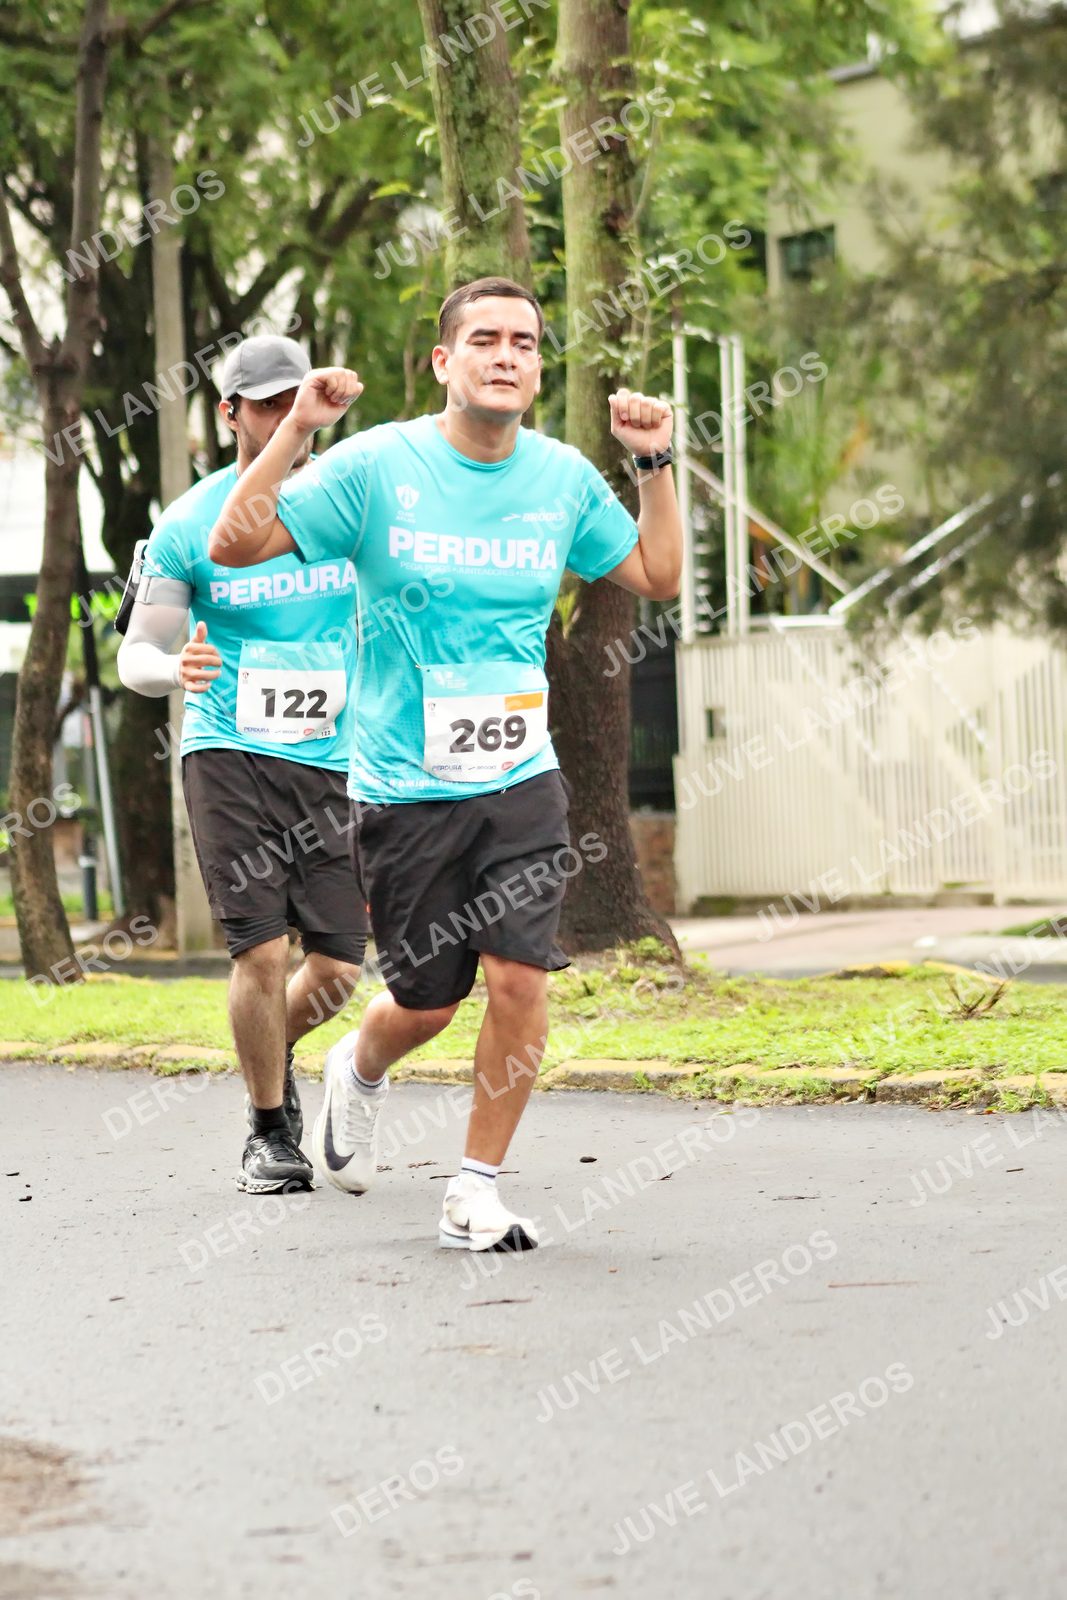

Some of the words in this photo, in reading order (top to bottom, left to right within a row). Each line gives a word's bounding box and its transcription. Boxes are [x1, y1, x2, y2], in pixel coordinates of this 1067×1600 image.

[389, 526, 557, 570] PERDURA
[210, 560, 356, 605] PERDURA
[261, 688, 327, 718] 122
[449, 715, 527, 753] 269
